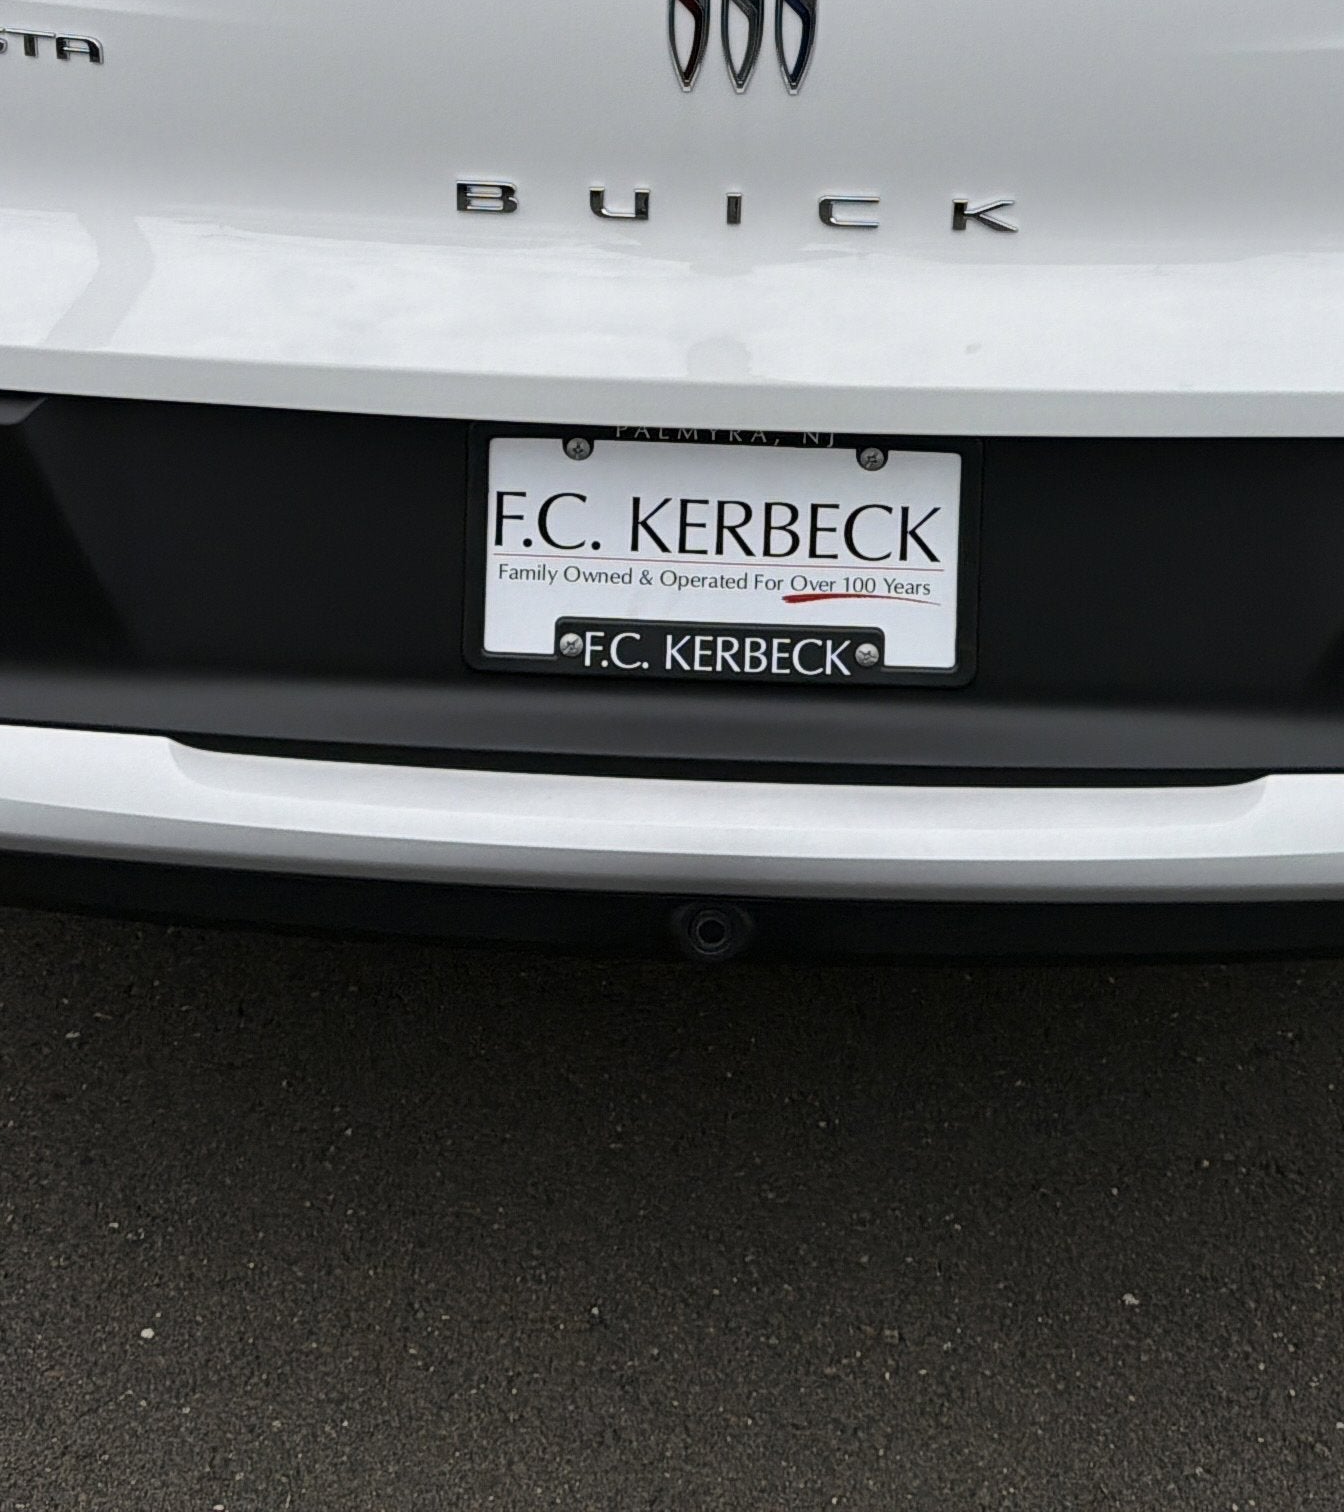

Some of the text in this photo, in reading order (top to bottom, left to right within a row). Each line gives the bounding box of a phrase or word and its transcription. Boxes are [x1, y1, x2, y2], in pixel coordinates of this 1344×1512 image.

[455, 178, 1019, 232] BUICK
[494, 490, 942, 563] F.C. KERBECK
[498, 563, 931, 596] Family Owned & Operated For Over 100 Years
[583, 630, 852, 677] F.C. KERBECK
